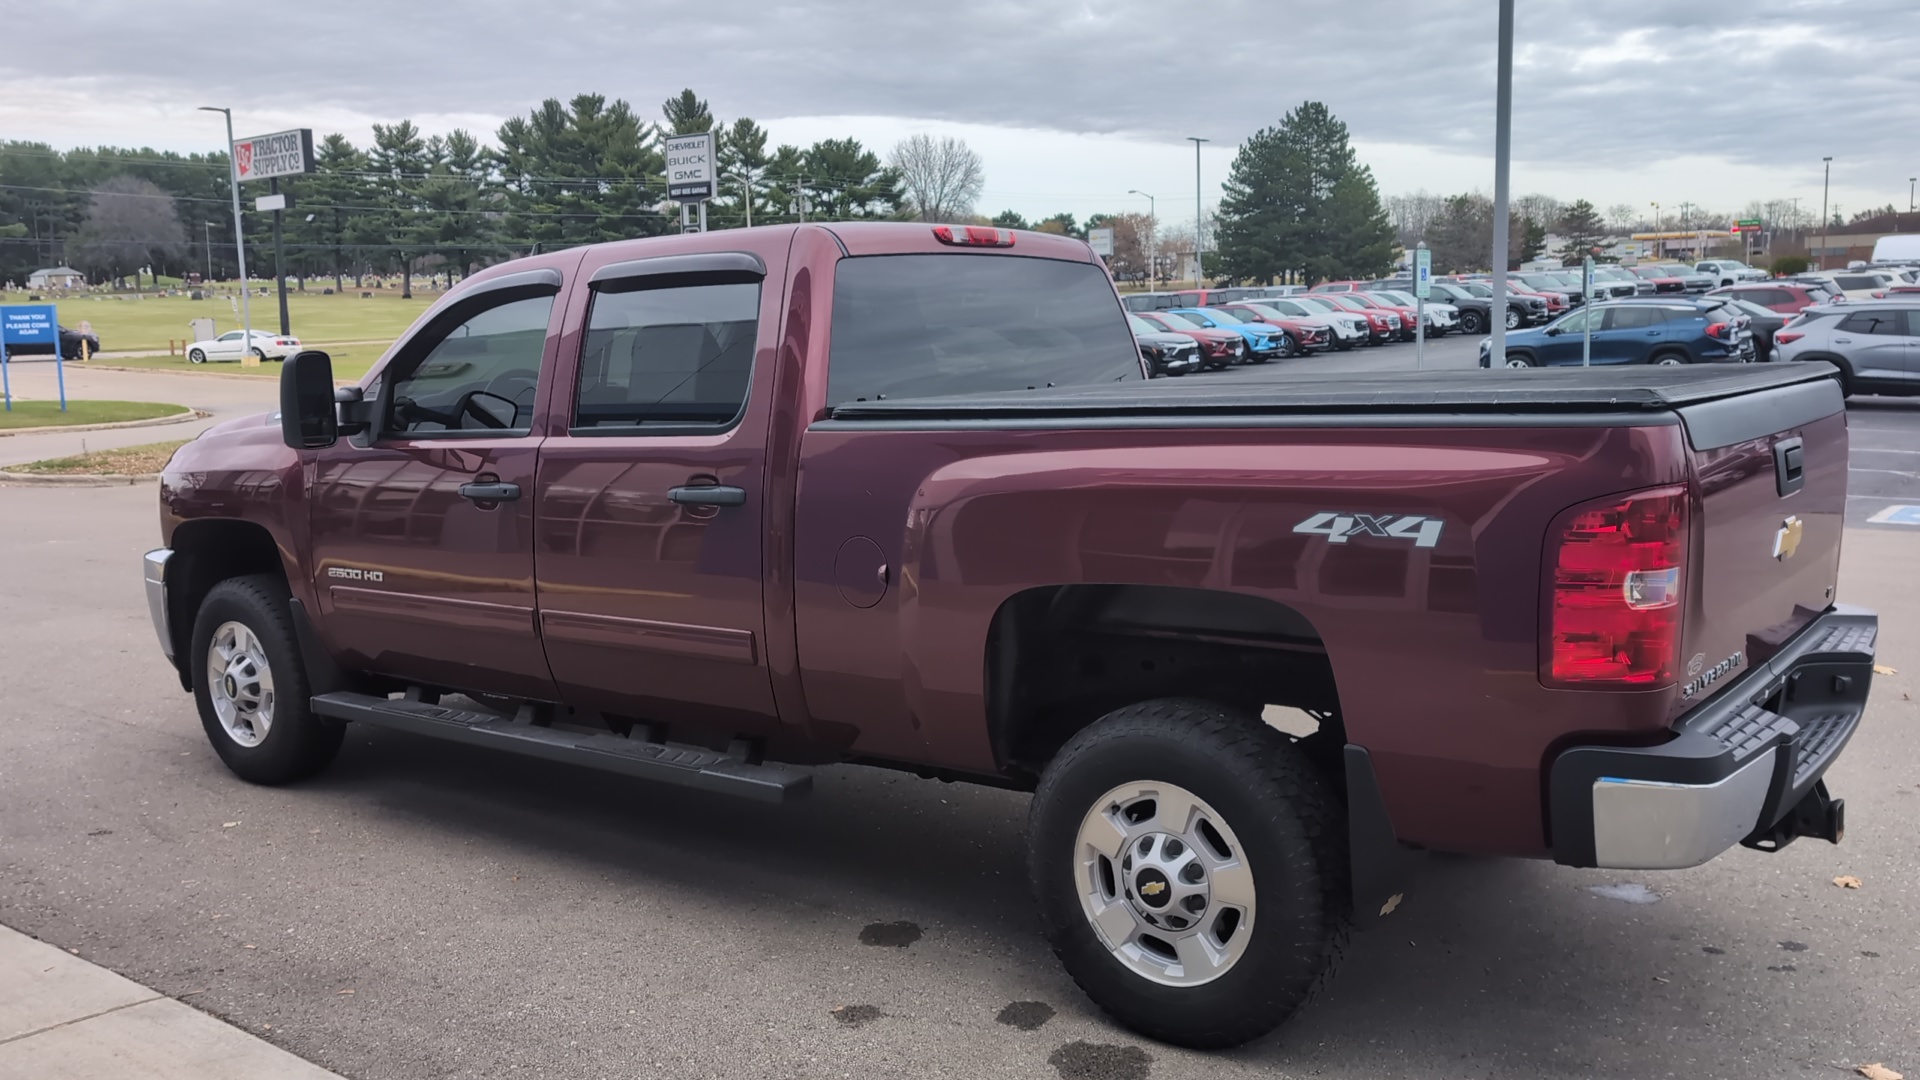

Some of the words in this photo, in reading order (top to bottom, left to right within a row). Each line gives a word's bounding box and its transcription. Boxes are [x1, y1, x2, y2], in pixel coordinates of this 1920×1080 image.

[252, 133, 298, 157] TRACTOR
[668, 140, 706, 151] CHEVROLET
[253, 154, 288, 175] SUPPLY
[668, 154, 706, 166] BUICK
[674, 169, 702, 180] GMC
[328, 567, 362, 580] 2500
[1682, 650, 1742, 700] SILVERADO
